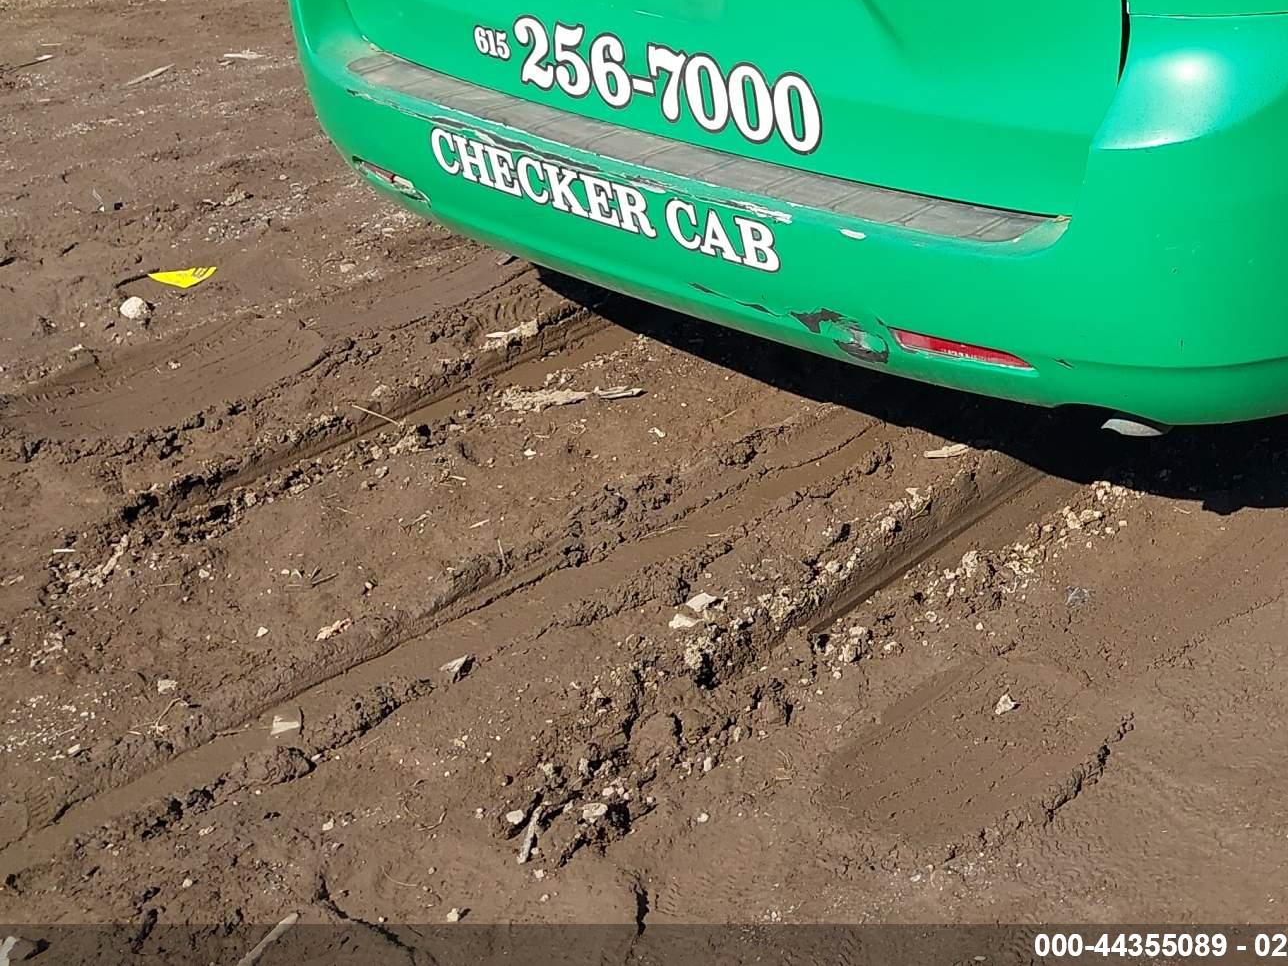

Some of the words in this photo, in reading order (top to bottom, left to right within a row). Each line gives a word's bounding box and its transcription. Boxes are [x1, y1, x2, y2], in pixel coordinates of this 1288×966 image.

[474, 25, 511, 60] 615
[513, 12, 822, 155] 256-7000
[430, 127, 658, 239] CHECKER
[665, 197, 781, 273] CAB
